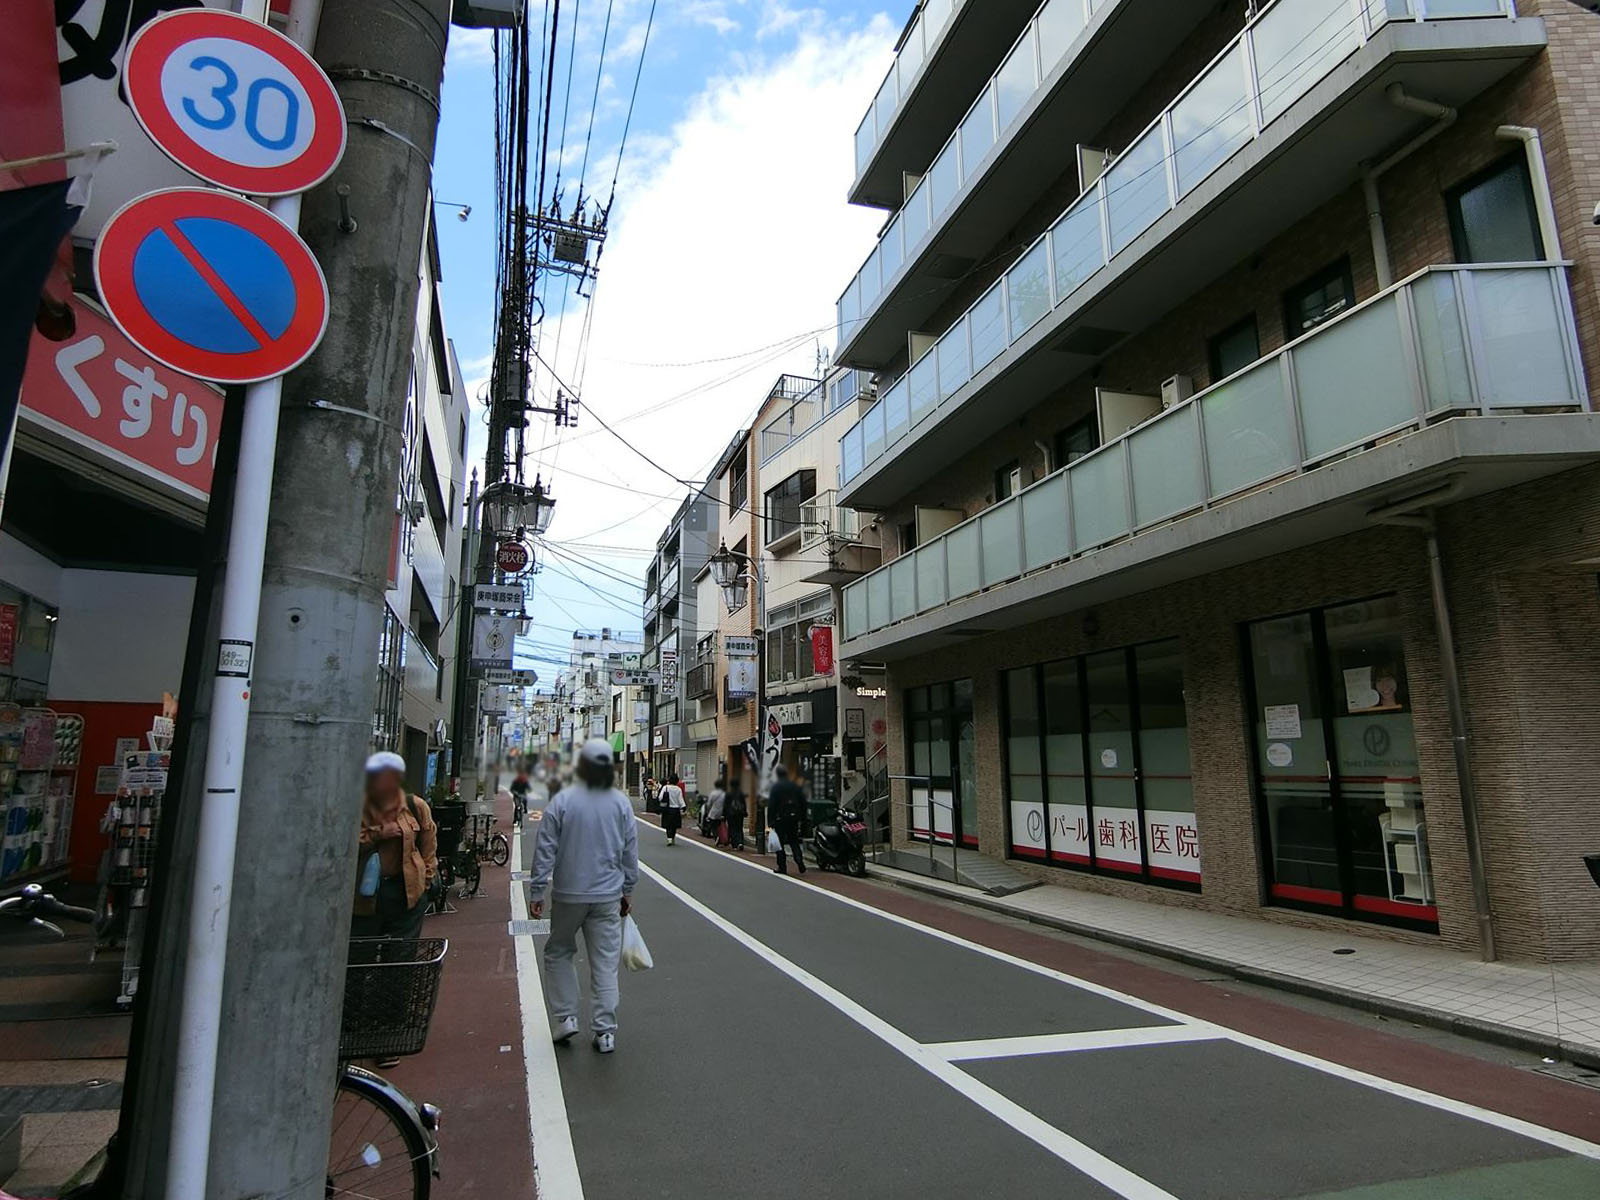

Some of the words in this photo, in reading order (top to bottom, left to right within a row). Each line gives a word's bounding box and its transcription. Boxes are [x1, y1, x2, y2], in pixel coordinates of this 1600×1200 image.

[182, 55, 299, 151] 30
[55, 334, 218, 466] くすり
[499, 550, 526, 564] 消火栓
[818, 634, 829, 667] 美容室
[856, 686, 887, 699] Simple
[1052, 814, 1200, 859] パール歯科医院
